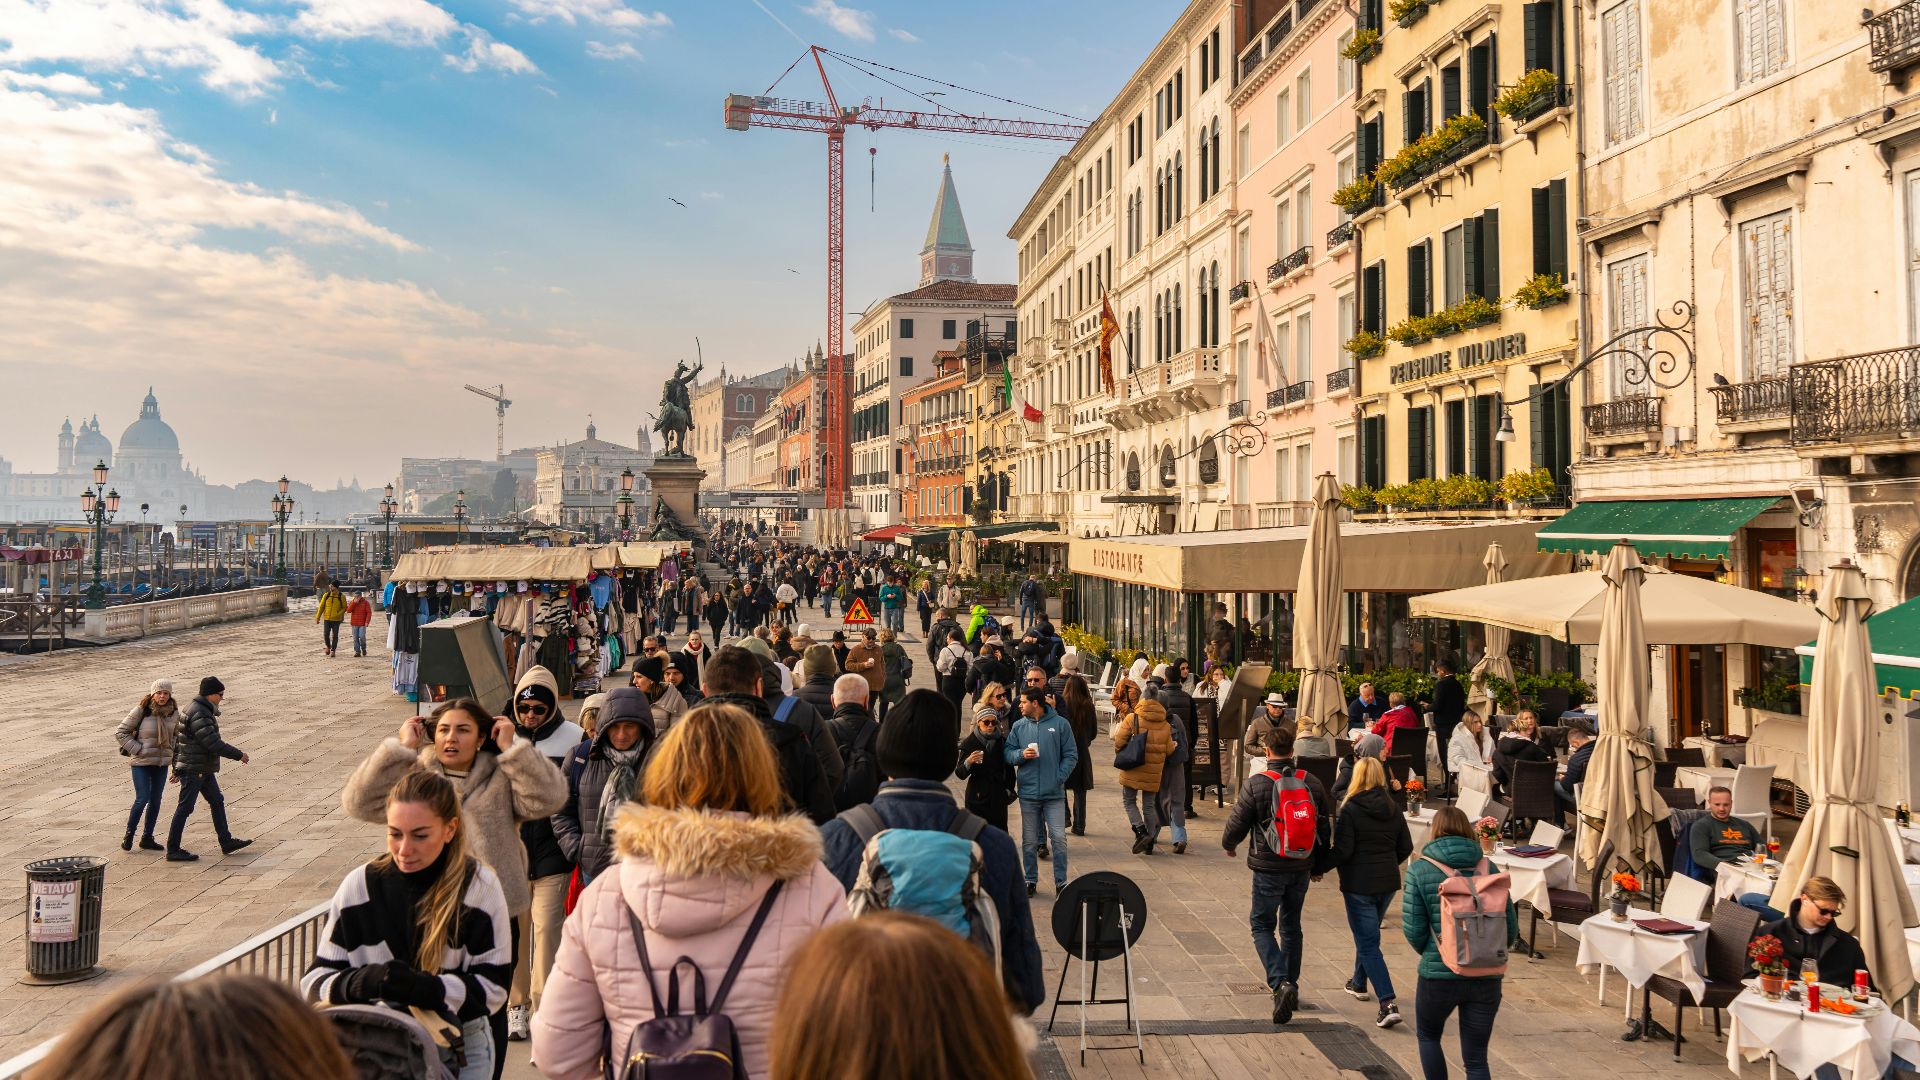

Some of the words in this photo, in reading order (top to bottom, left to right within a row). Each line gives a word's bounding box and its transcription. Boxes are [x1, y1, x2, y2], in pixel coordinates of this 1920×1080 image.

[1390, 350, 1451, 384] PENSIONE
[1458, 332, 1526, 368] WILDNER
[1093, 548, 1143, 573] RISTORANTE
[33, 881, 75, 895] VIETATO
